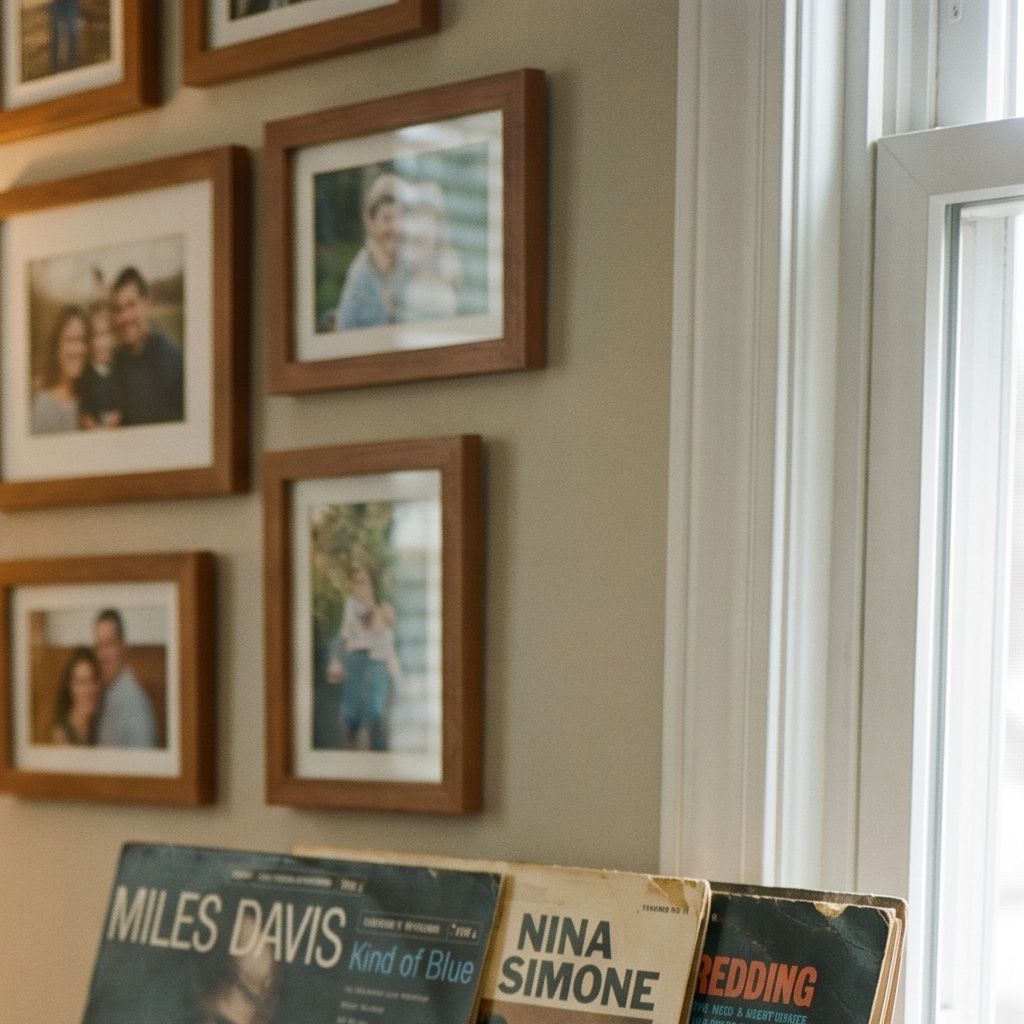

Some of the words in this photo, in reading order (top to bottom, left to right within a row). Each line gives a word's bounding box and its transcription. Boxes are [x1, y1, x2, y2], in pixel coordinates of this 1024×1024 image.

[107, 885, 223, 953] MILES
[229, 898, 347, 969] DAVIS
[517, 913, 612, 960] NINA
[348, 941, 398, 975] Kind
[399, 948, 425, 978] of
[425, 949, 475, 984] Blue
[498, 955, 660, 1011] SIMONE
[695, 953, 817, 1008] REDDING
